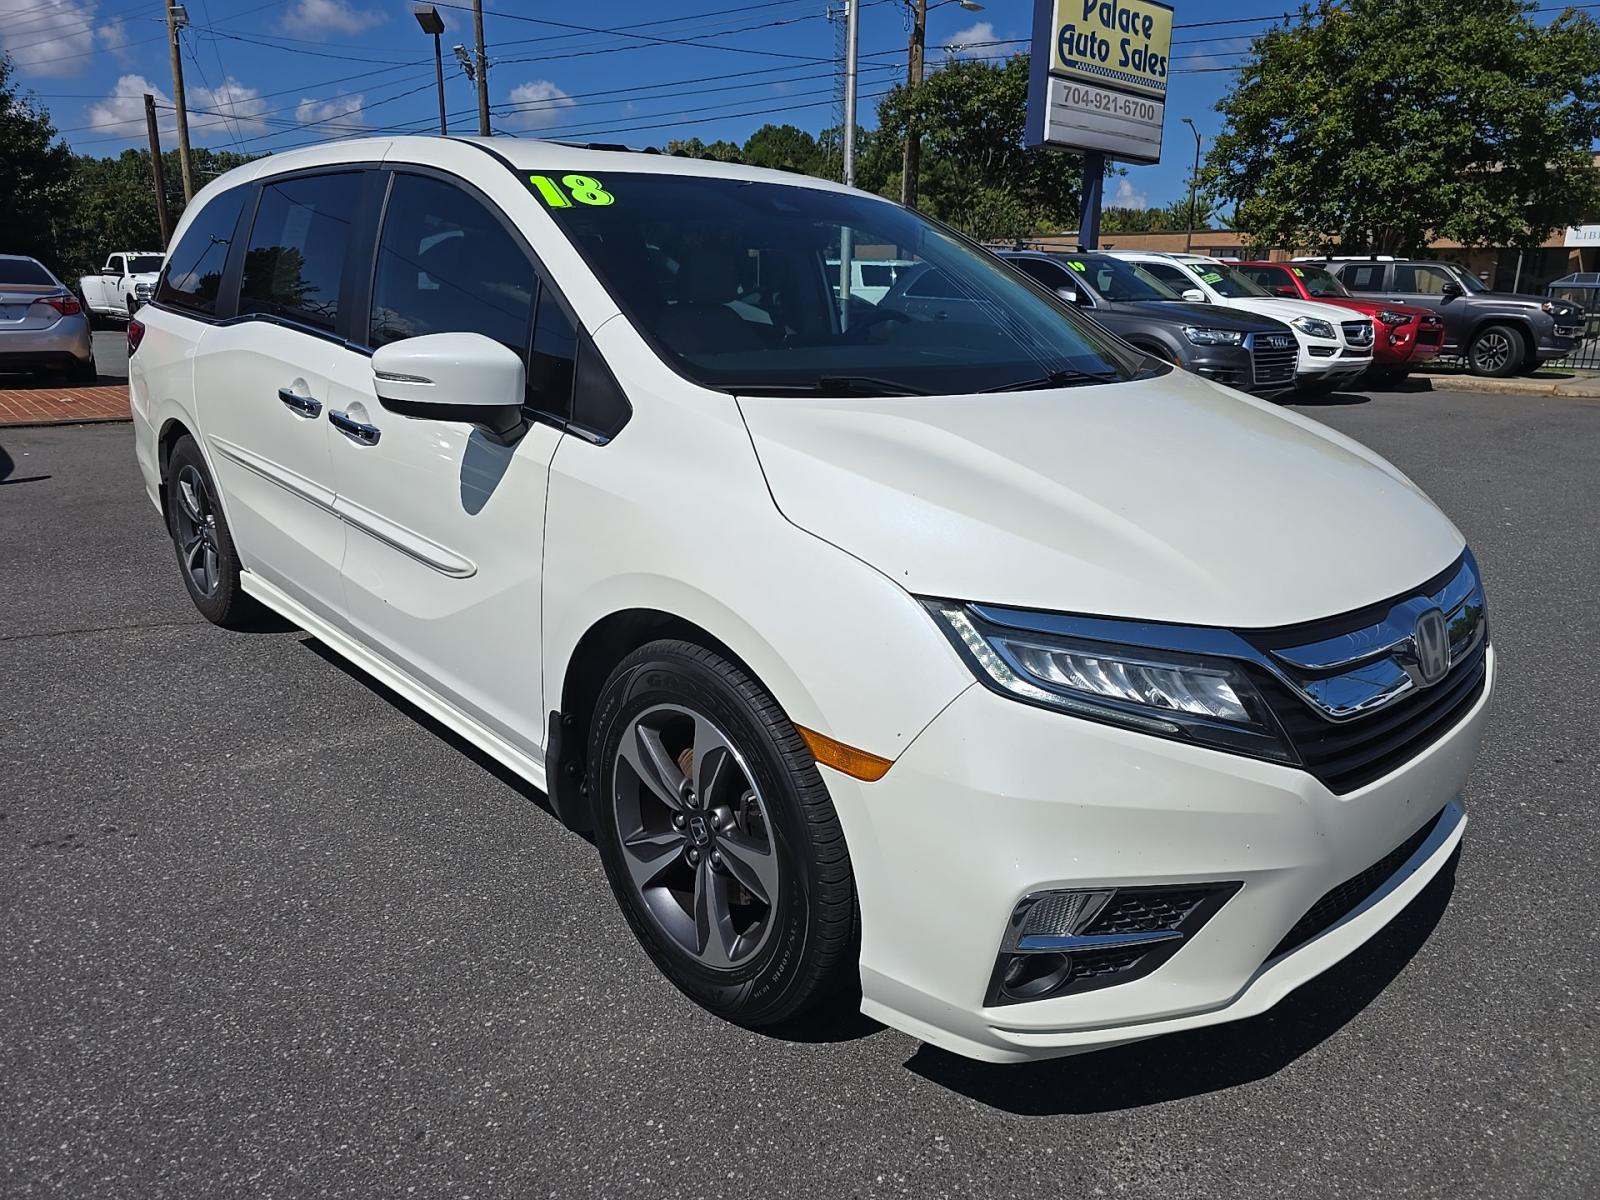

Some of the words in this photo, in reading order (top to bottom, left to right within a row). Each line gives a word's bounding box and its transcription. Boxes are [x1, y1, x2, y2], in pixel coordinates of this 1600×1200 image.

[1082, 0, 1154, 40] Palace
[1058, 23, 1110, 68] Auto
[1118, 37, 1167, 78] Sales
[1063, 85, 1155, 121] 704-921-6700
[529, 174, 615, 208] 18
[1066, 261, 1086, 272] 19
